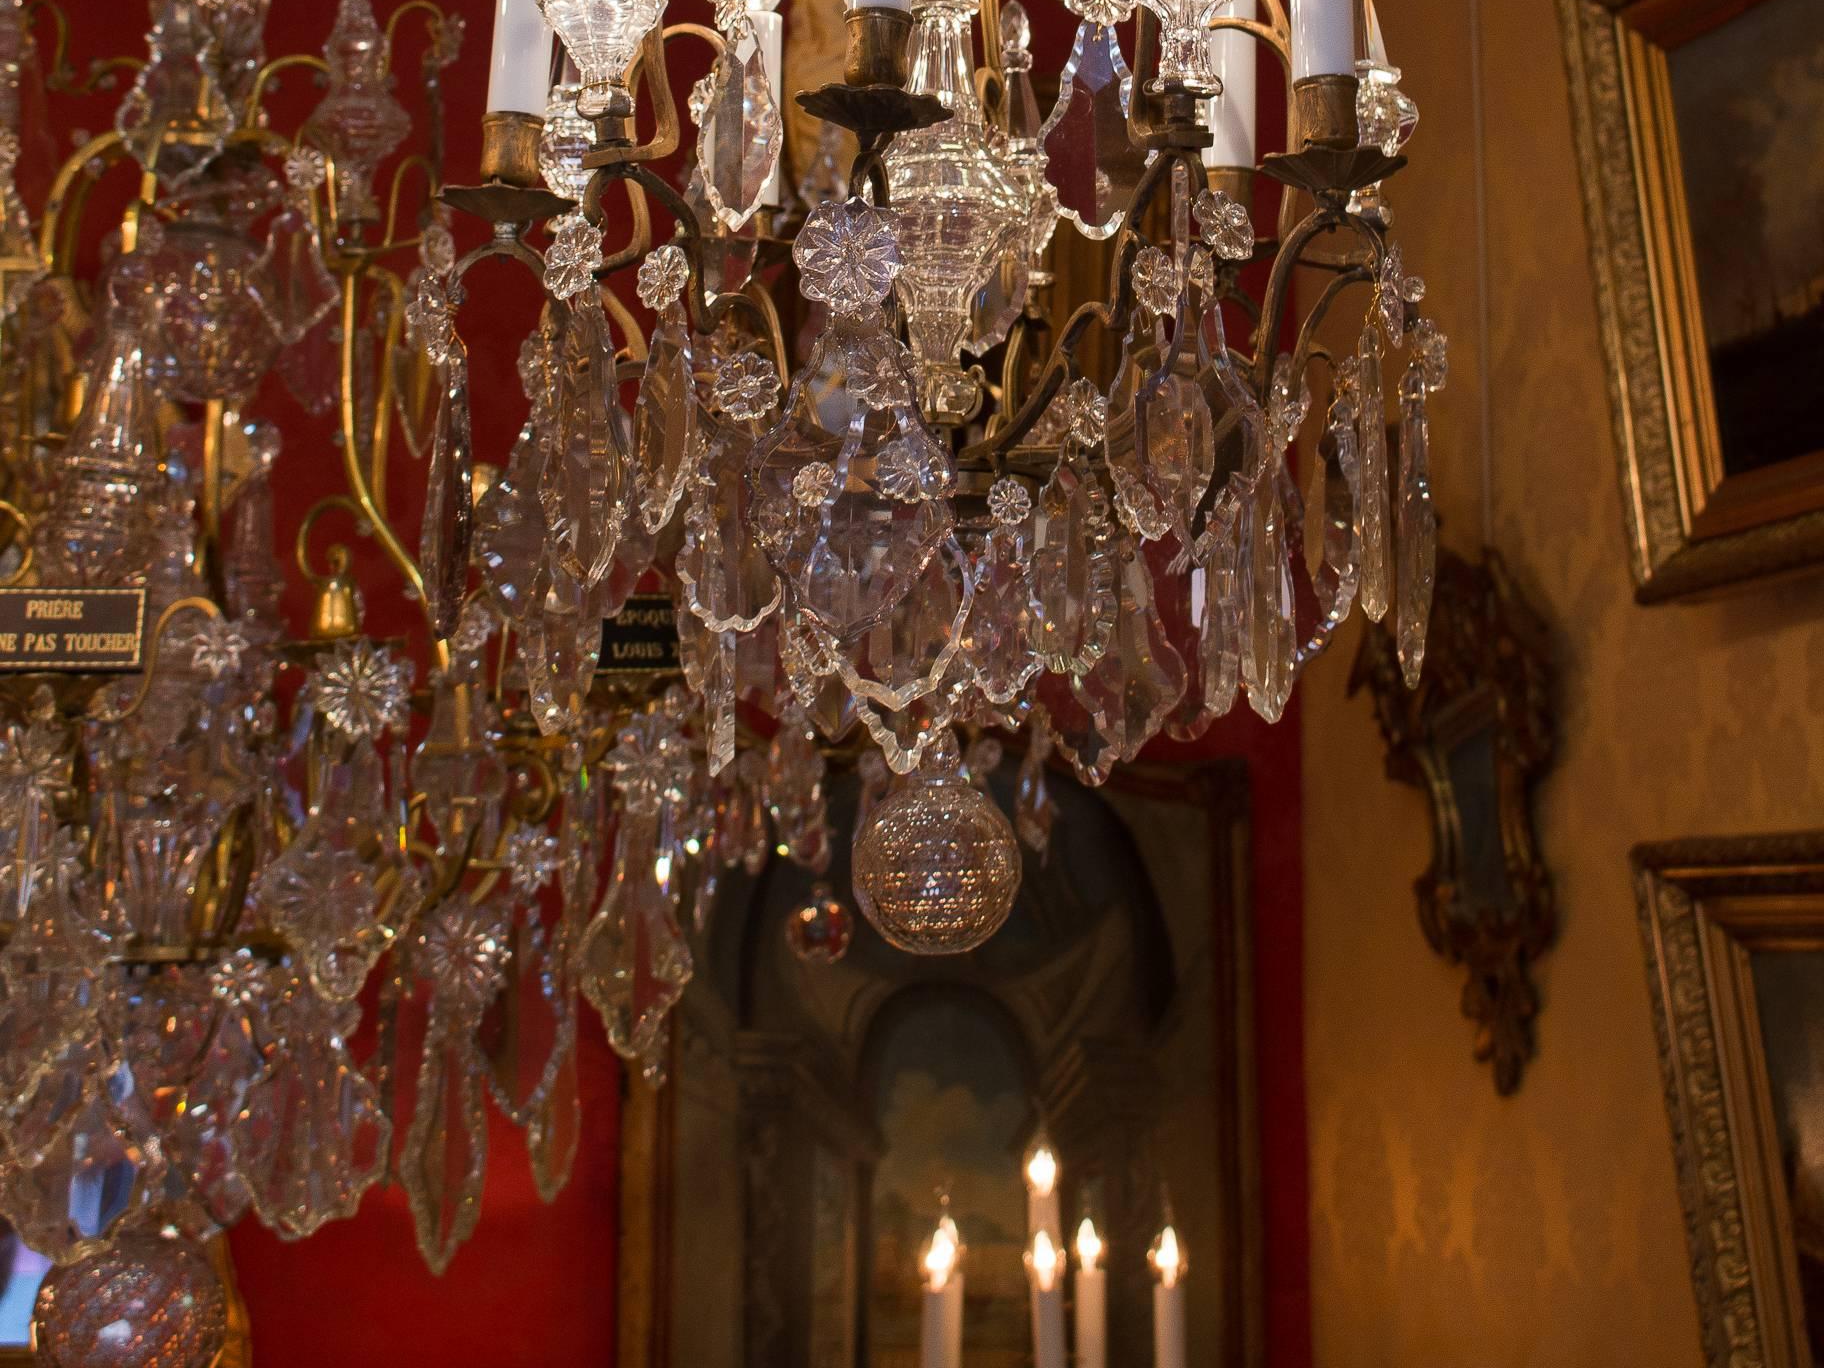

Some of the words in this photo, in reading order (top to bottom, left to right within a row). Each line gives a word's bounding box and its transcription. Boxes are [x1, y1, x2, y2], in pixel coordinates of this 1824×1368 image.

[0, 633, 17, 652] NE
[23, 633, 57, 652] PAS
[63, 633, 139, 652] TOUCHER
[612, 641, 663, 660] LOUIS
